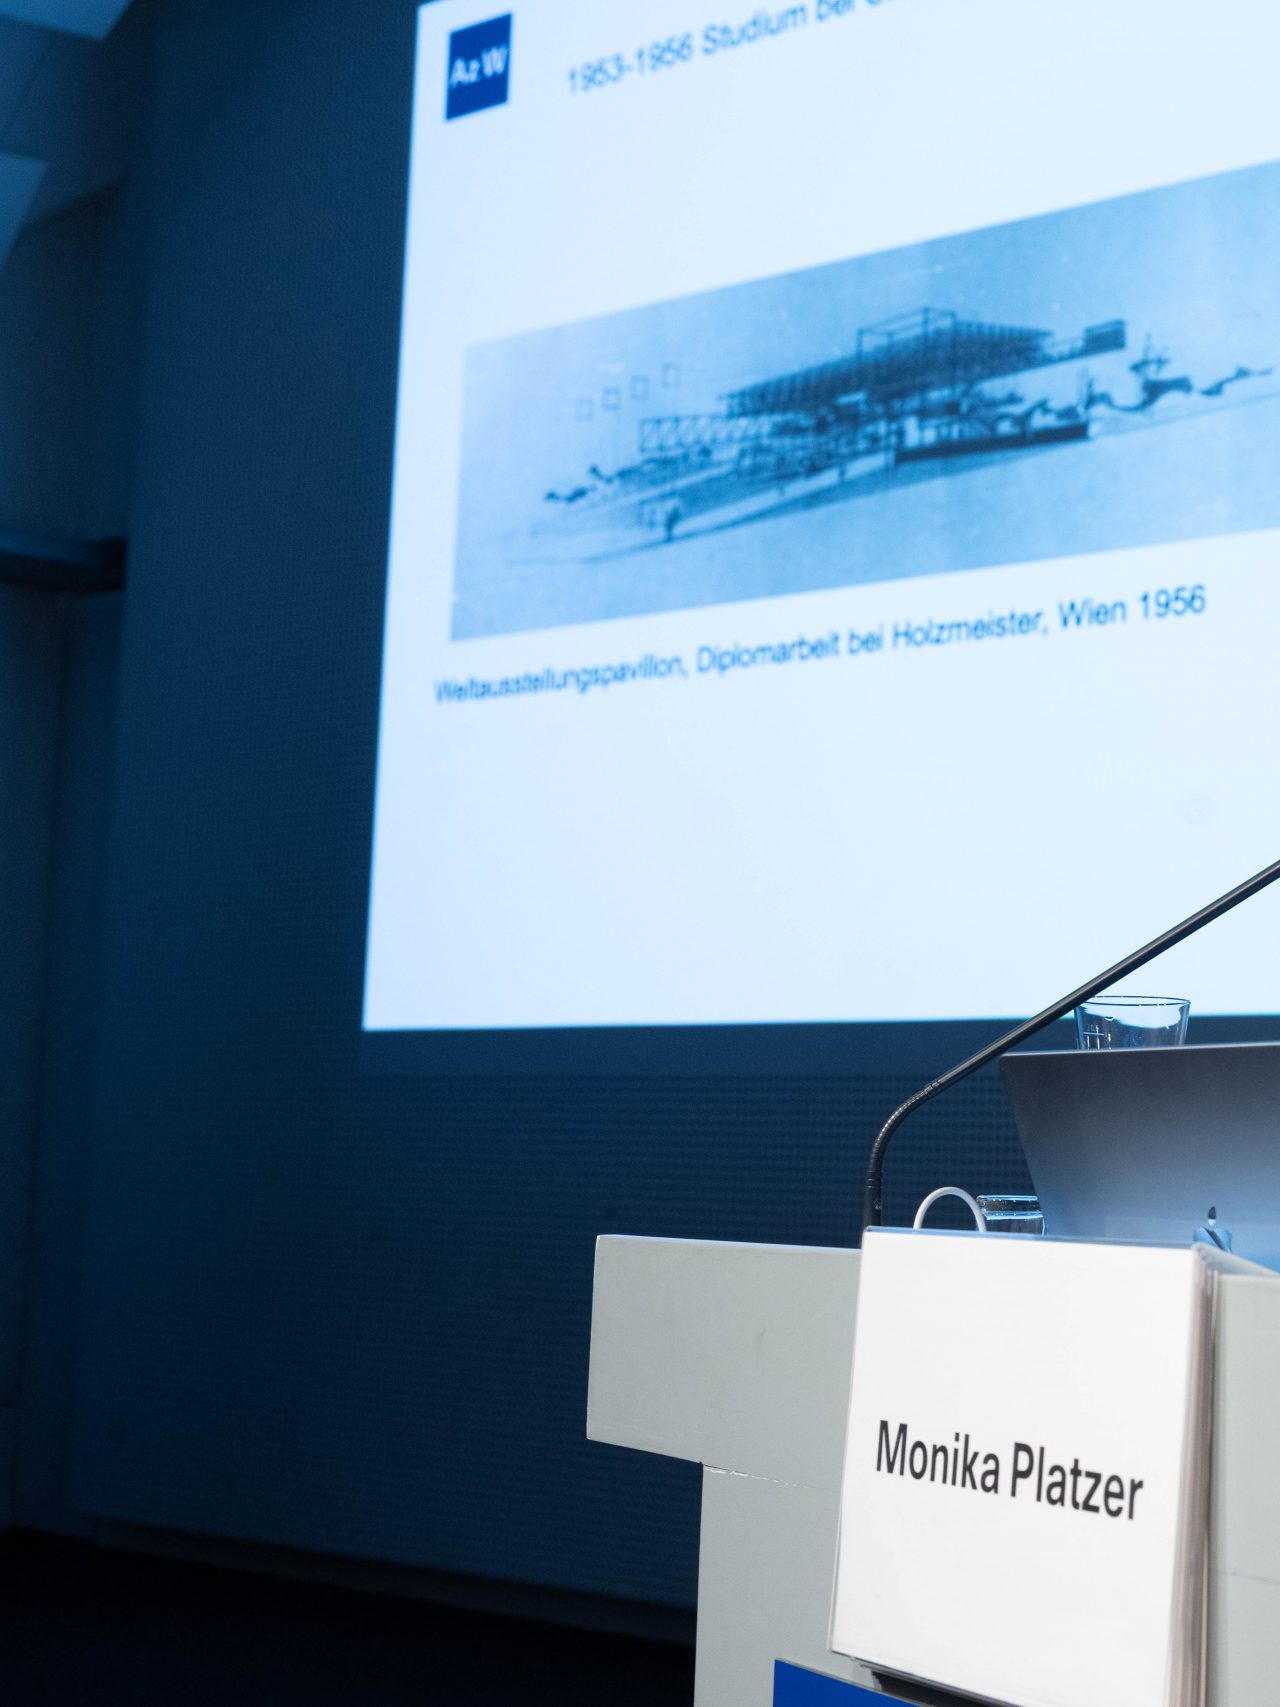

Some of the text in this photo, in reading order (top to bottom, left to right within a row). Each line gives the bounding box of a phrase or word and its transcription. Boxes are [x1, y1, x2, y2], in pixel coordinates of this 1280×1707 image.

[568, 32, 694, 95] 1953-1956
[702, 6, 808, 55] Studium
[697, 631, 841, 675] Diplomarbeit
[847, 631, 885, 656] bei
[892, 609, 1050, 650] Holzmeister,
[1058, 599, 1127, 630] Wien
[1140, 584, 1206, 620] 1956
[876, 1419, 1144, 1520] Monika Platzer
